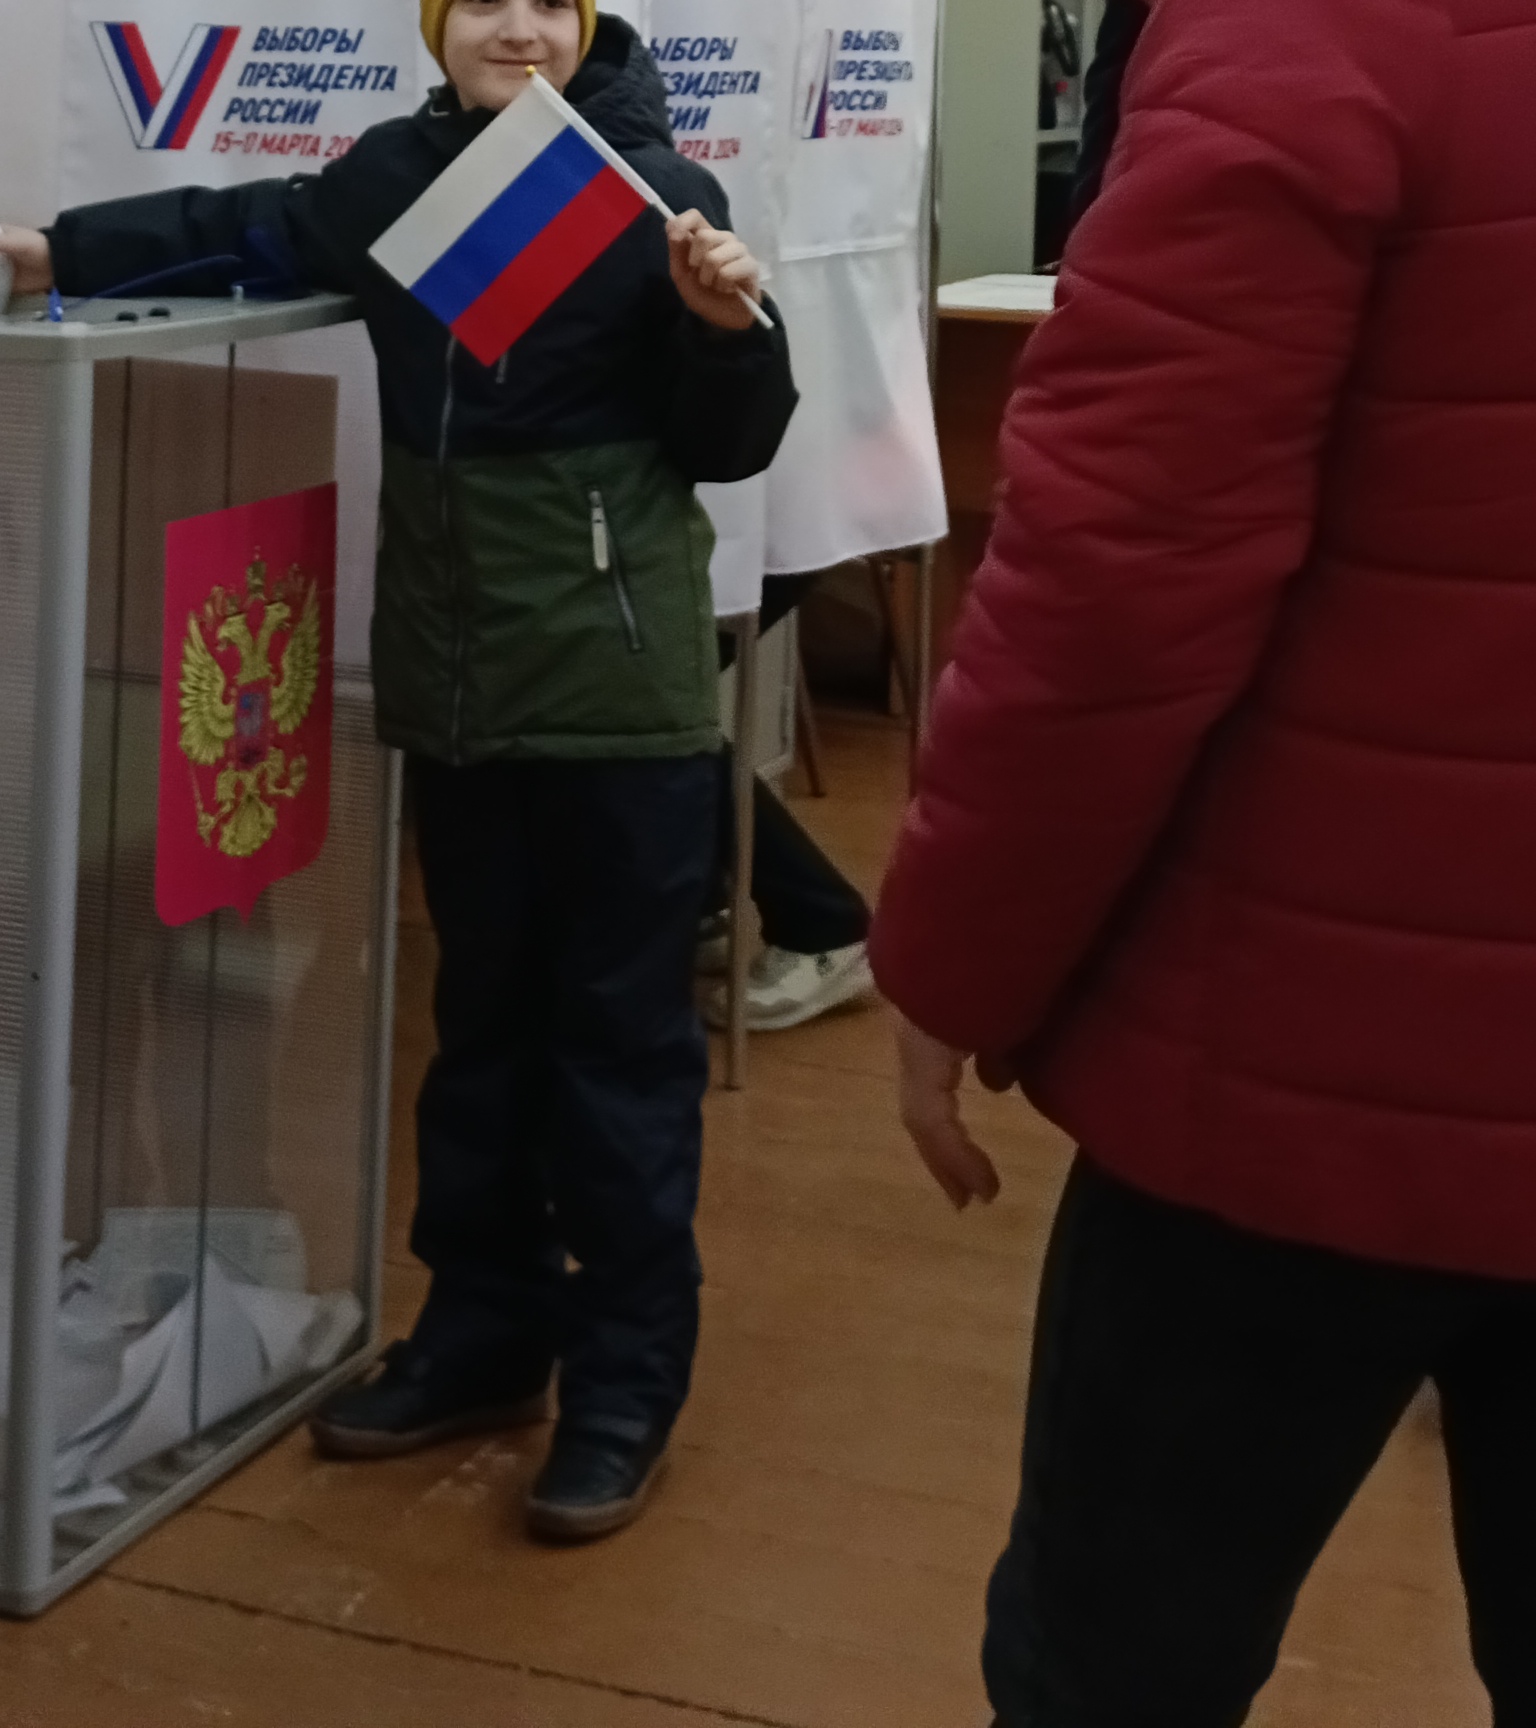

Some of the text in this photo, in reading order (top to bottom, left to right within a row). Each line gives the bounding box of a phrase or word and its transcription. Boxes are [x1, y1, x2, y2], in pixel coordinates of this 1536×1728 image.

[251, 26, 366, 55] ВЫБОРЫ
[650, 36, 739, 62] ЫБОРЫ
[237, 61, 399, 93] ПРЕЗИДЕНТА
[664, 71, 761, 99] ЗИДЕНТА
[222, 97, 322, 125] РОССИИ
[257, 133, 322, 157] МАРТА
[323, 135, 357, 159] 20
[675, 139, 711, 160] РТА
